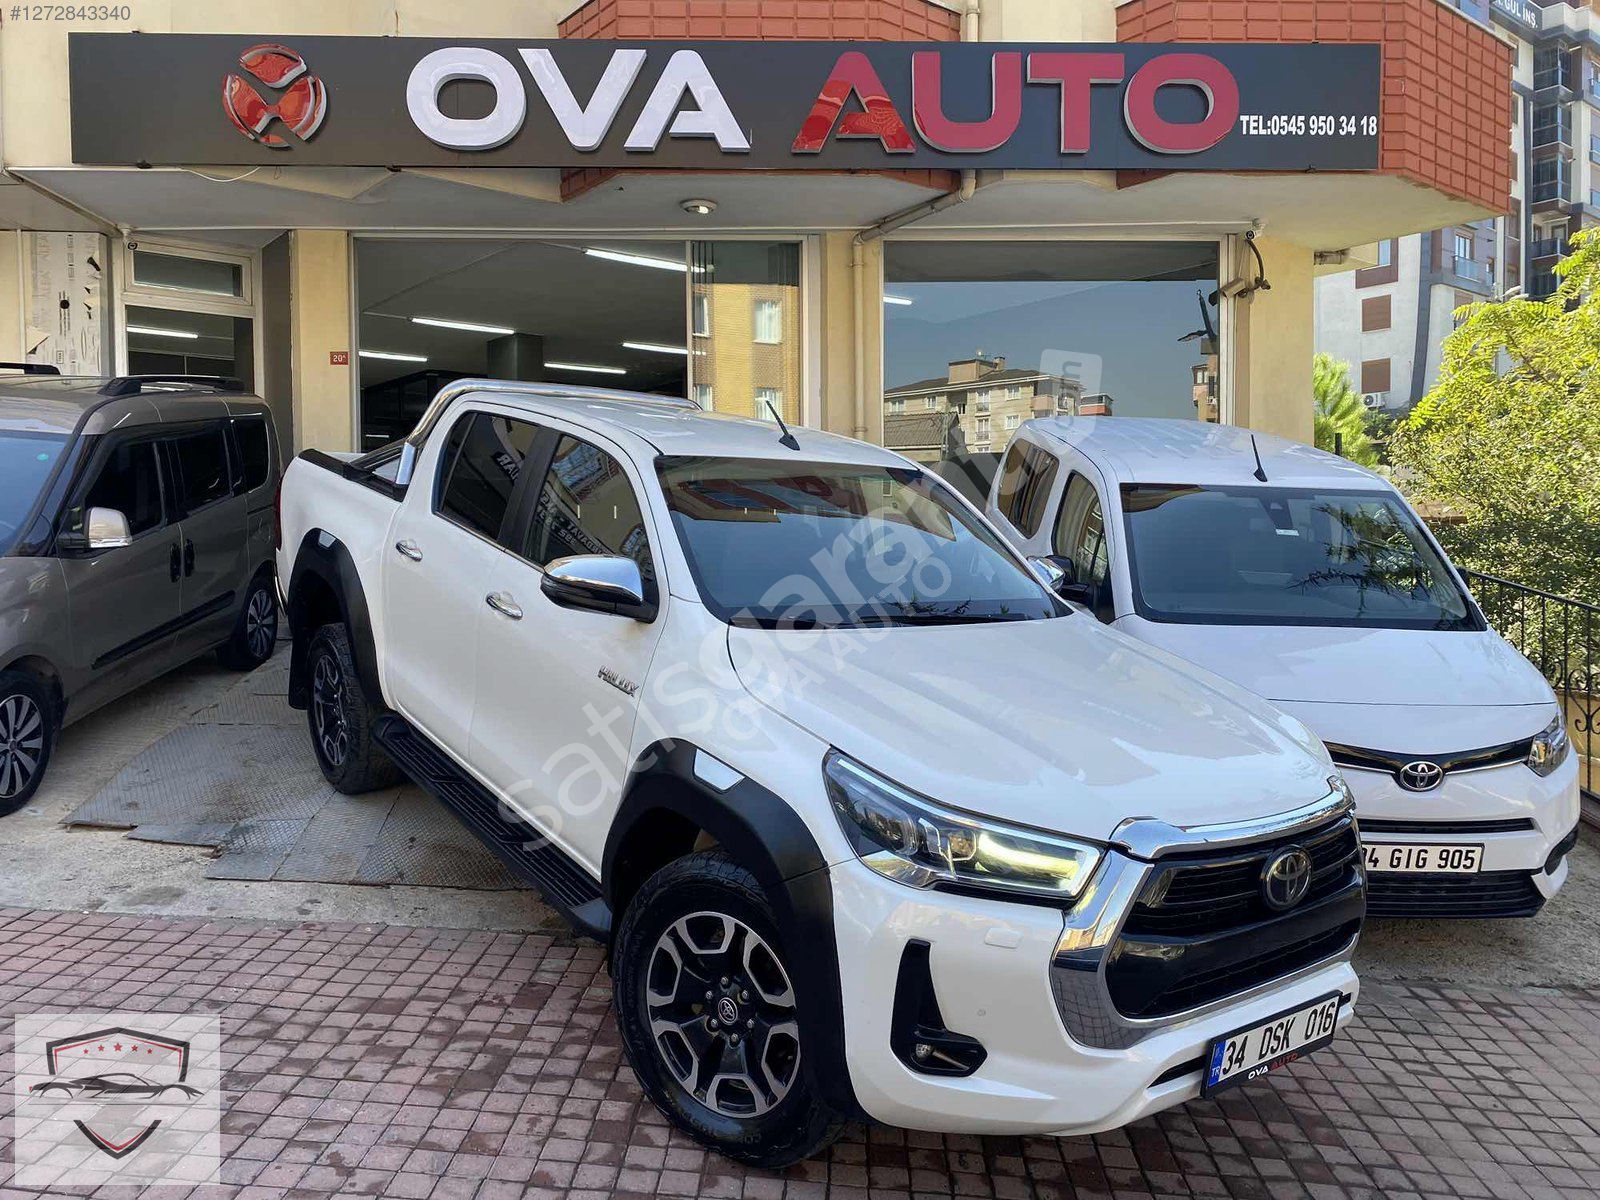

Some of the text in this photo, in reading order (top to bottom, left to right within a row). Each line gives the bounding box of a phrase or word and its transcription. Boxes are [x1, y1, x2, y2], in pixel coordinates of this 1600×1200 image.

[406, 46, 1240, 155] OVA AUTO
[1240, 115, 1377, 135] TEL:0545 950 34 18
[1389, 848, 1429, 869] GIG
[1437, 848, 1476, 870] 905
[1222, 1001, 1335, 1075] 34 DSK 016
[1248, 1052, 1298, 1080] OVA AUTO
